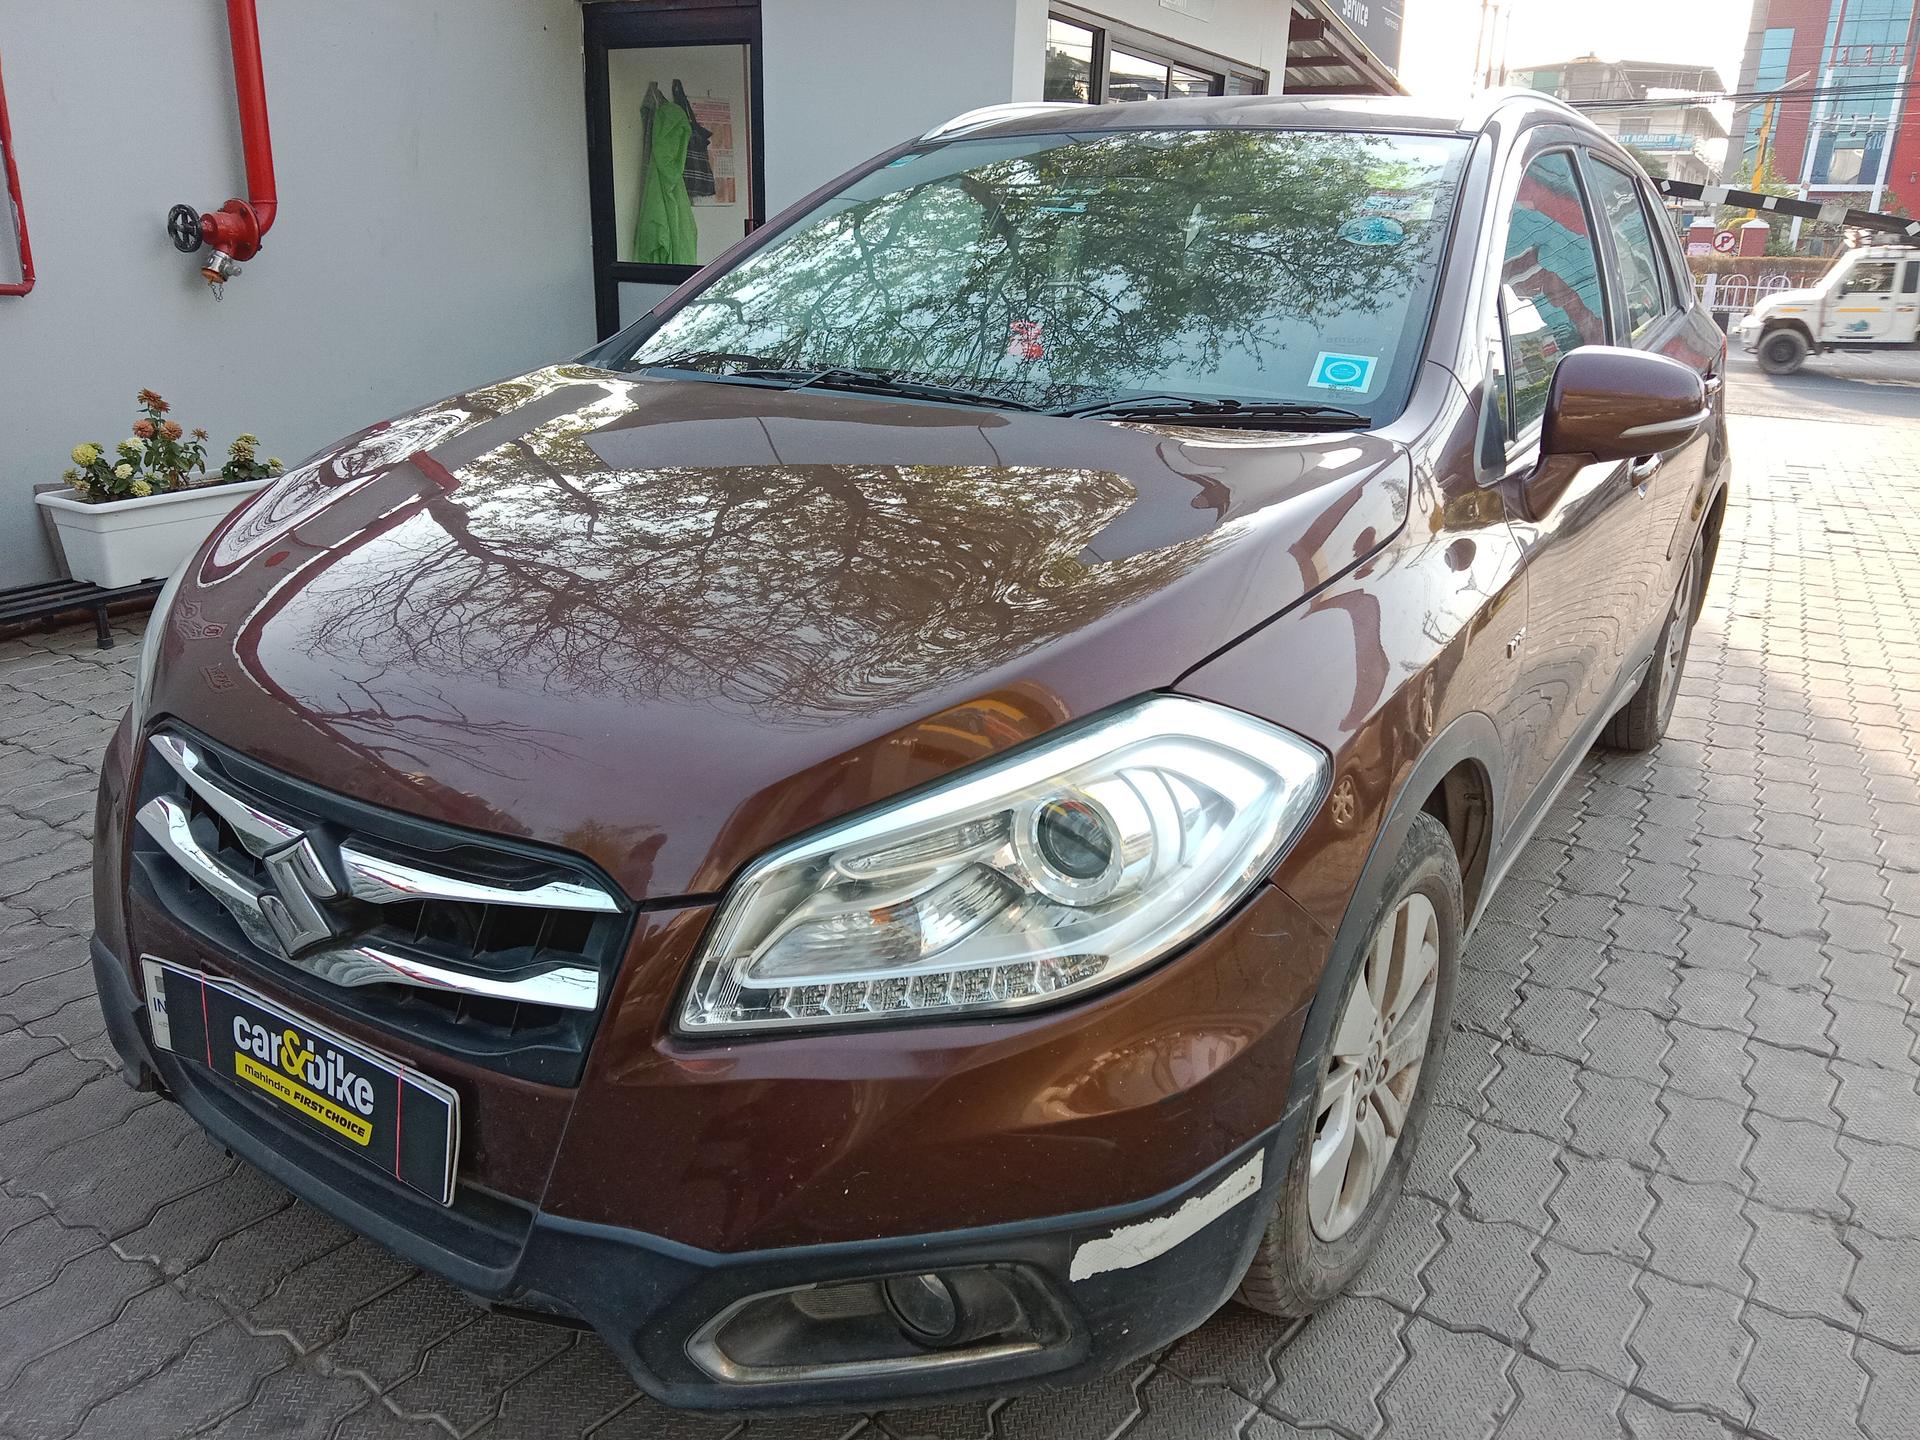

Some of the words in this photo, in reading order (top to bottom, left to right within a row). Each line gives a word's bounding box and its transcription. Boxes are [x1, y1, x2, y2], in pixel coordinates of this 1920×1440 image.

[1342, 0, 1369, 27] Service
[1631, 134, 1673, 143] ACADEMY
[233, 1015, 374, 1115] car&bike
[293, 1091, 325, 1114] FIRST
[325, 1109, 366, 1138] CHOICE
